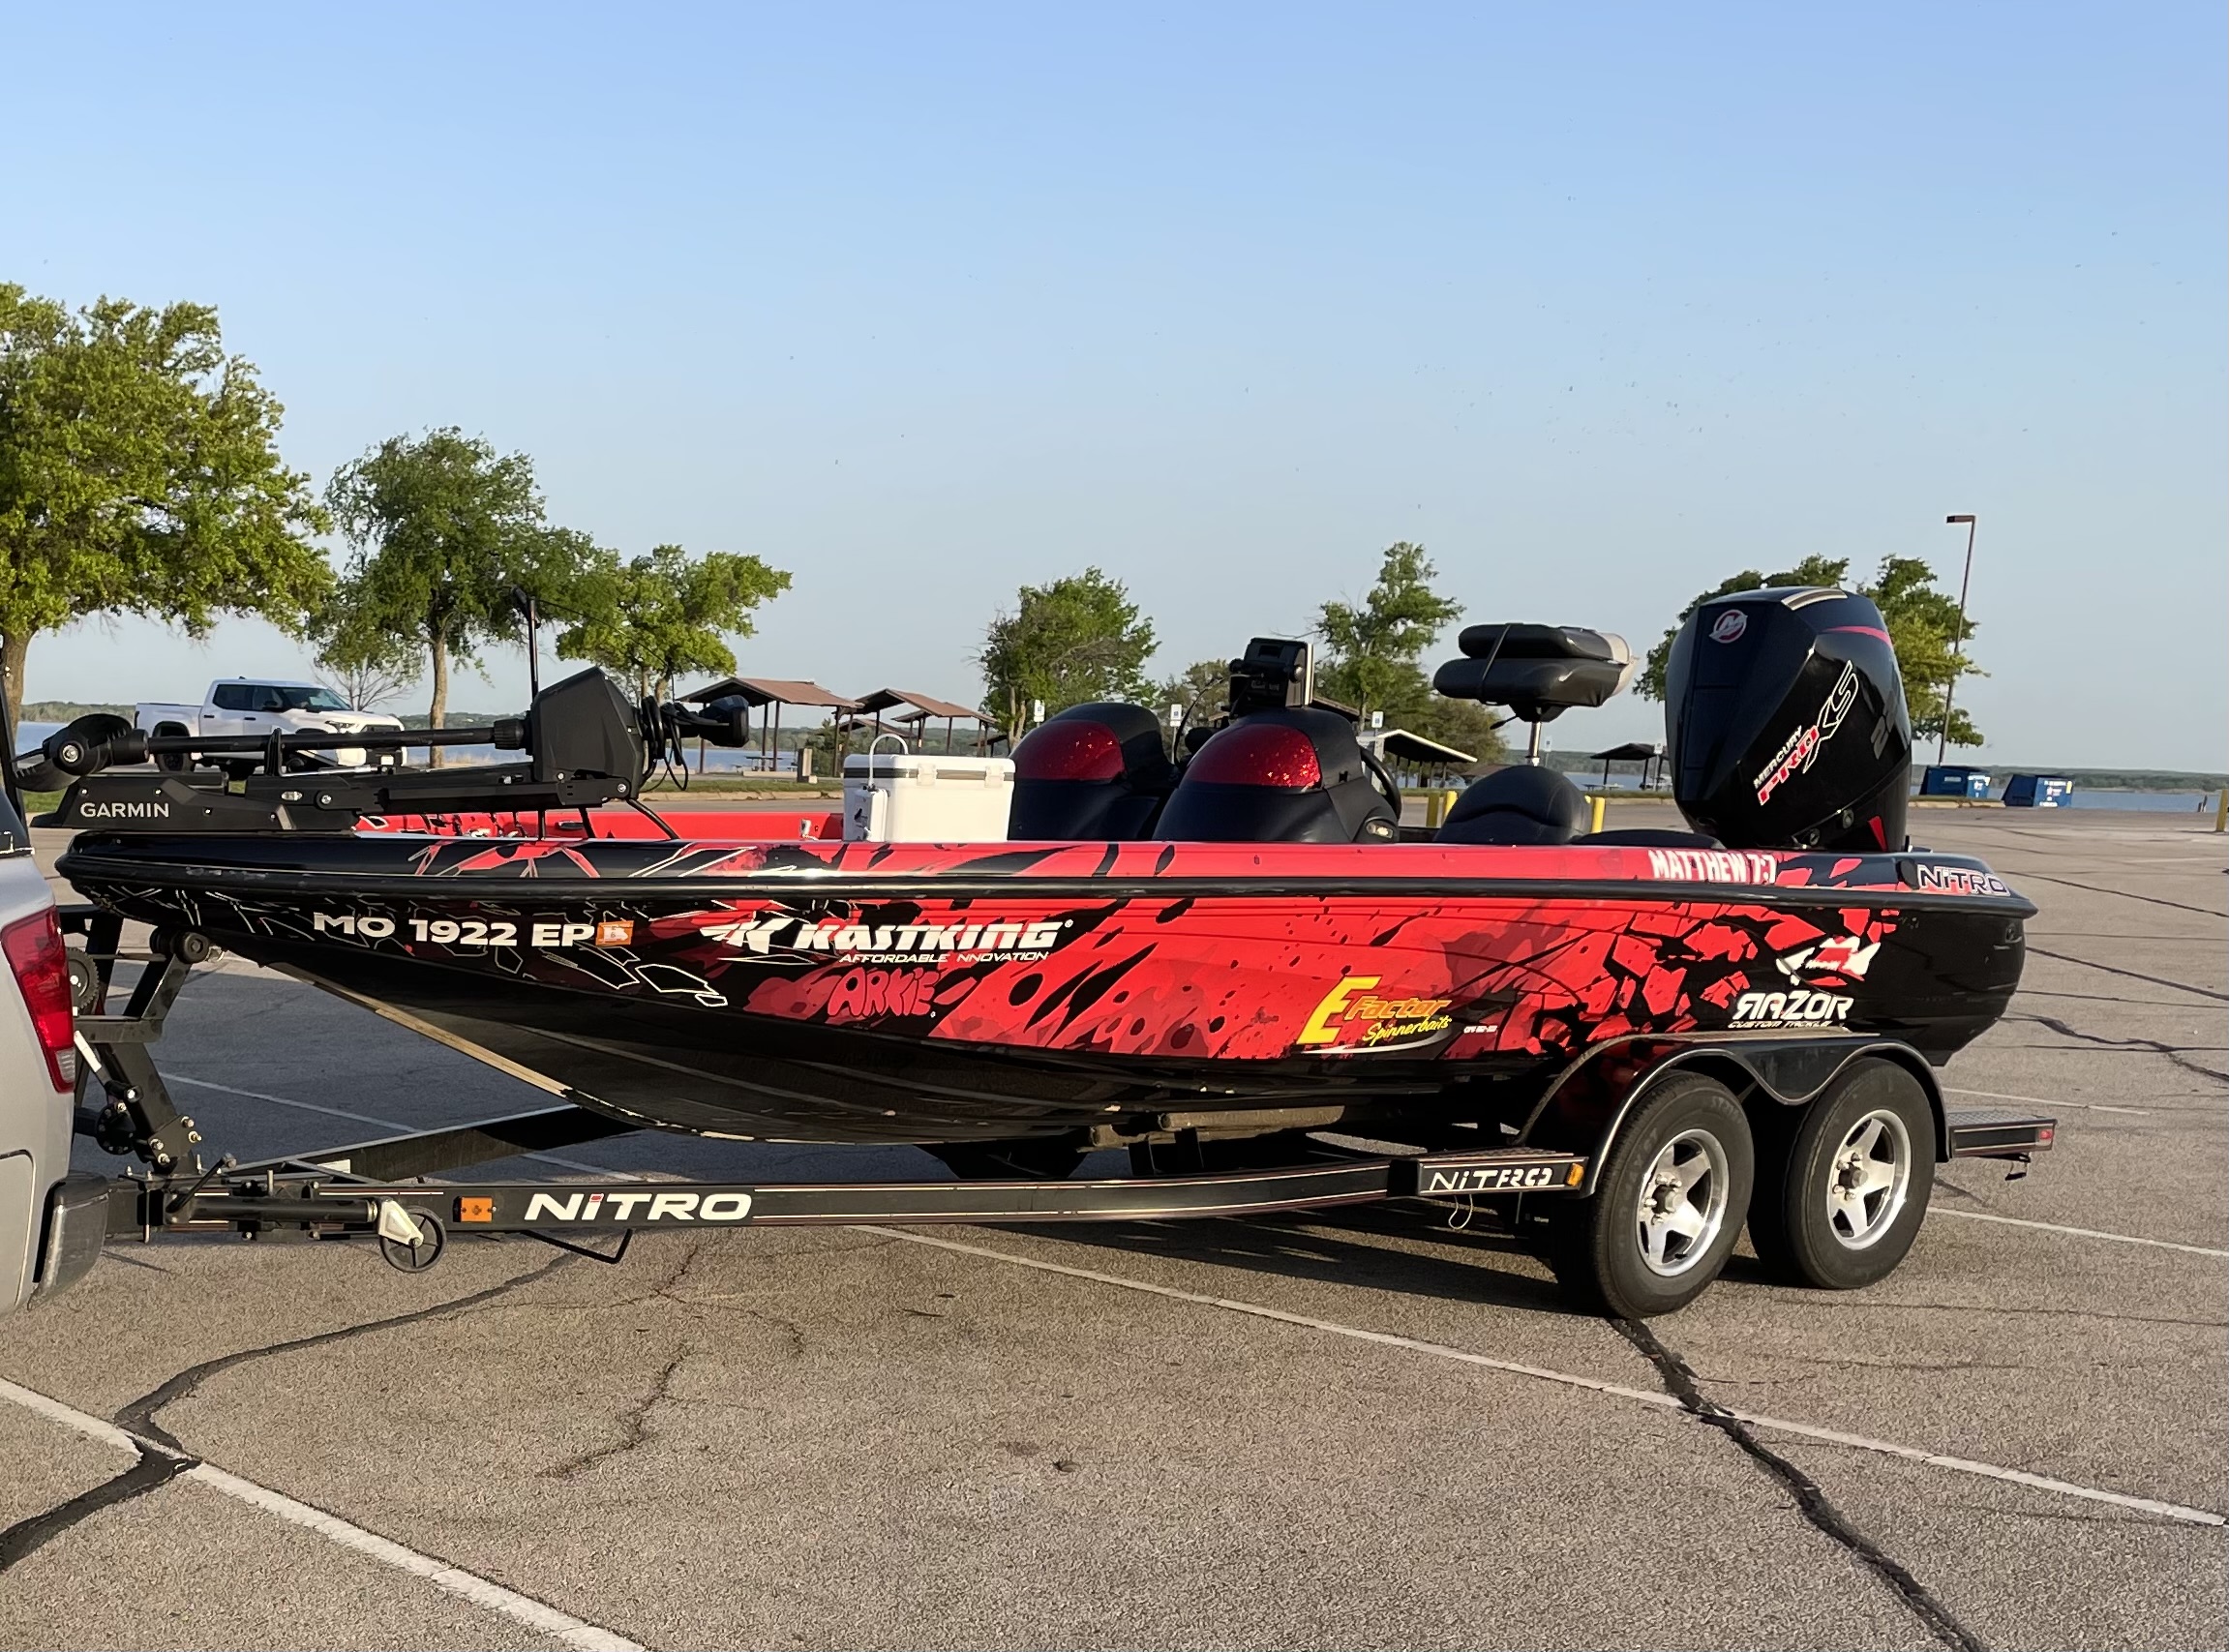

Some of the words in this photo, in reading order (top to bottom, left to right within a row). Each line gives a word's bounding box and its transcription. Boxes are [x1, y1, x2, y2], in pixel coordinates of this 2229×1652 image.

[1753, 725, 1802, 789] MERCURY
[79, 801, 169, 818] GARMIN
[1647, 849, 1747, 884] MATTHEW
[313, 912, 395, 938] MO
[408, 918, 518, 946] 1922
[531, 922, 595, 947] EP
[838, 953, 950, 964] AFFORDABLE
[1343, 995, 1452, 1021] Factor
[1732, 989, 1854, 1021] RAZOR
[1362, 1014, 1452, 1047] Spinnerbaits
